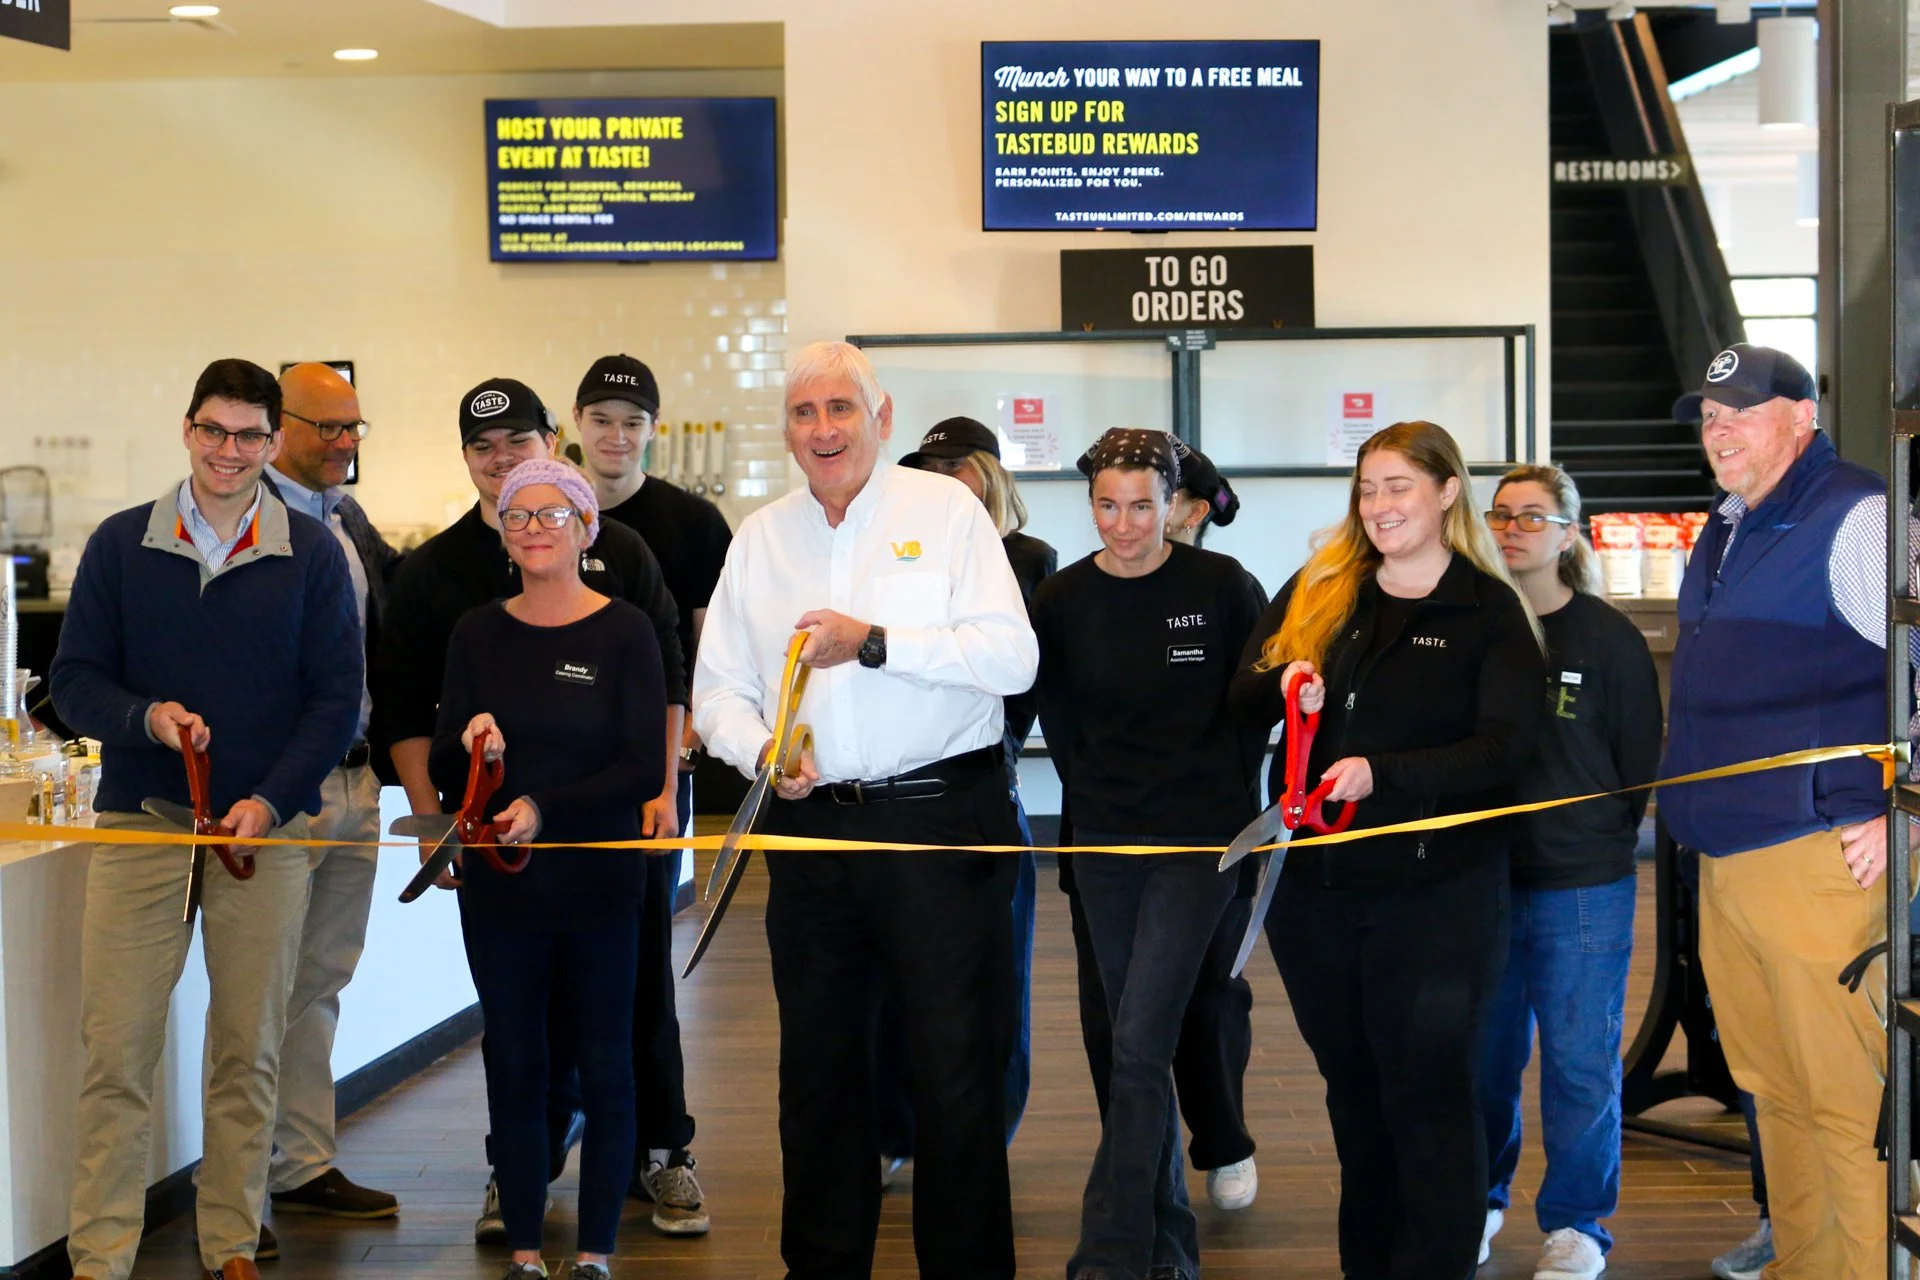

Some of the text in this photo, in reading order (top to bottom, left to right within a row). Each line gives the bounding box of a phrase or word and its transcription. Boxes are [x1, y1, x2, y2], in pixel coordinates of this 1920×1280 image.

[994, 65, 1302, 92] Munch YOUR WAY TO A FREE MEAL
[995, 100, 1125, 122] SIGN UP FOR
[497, 116, 683, 140] HOST YOUR PRIVATE
[995, 132, 1199, 155] TASTEBUD REWARDS
[498, 147, 650, 168] EVENT AT TASTE!
[995, 167, 1164, 176] EARN POINTS. ENJOY PERKS.
[995, 178, 1142, 188] PERSONALIZED FOR YOU.
[1055, 212, 1244, 221] TASTEUNLIMITED.COM/REWARDS
[1145, 255, 1227, 287] TO GO
[1132, 290, 1244, 322] ORDERS
[1172, 648, 1204, 656] Samantha
[564, 664, 588, 674] Brandy
